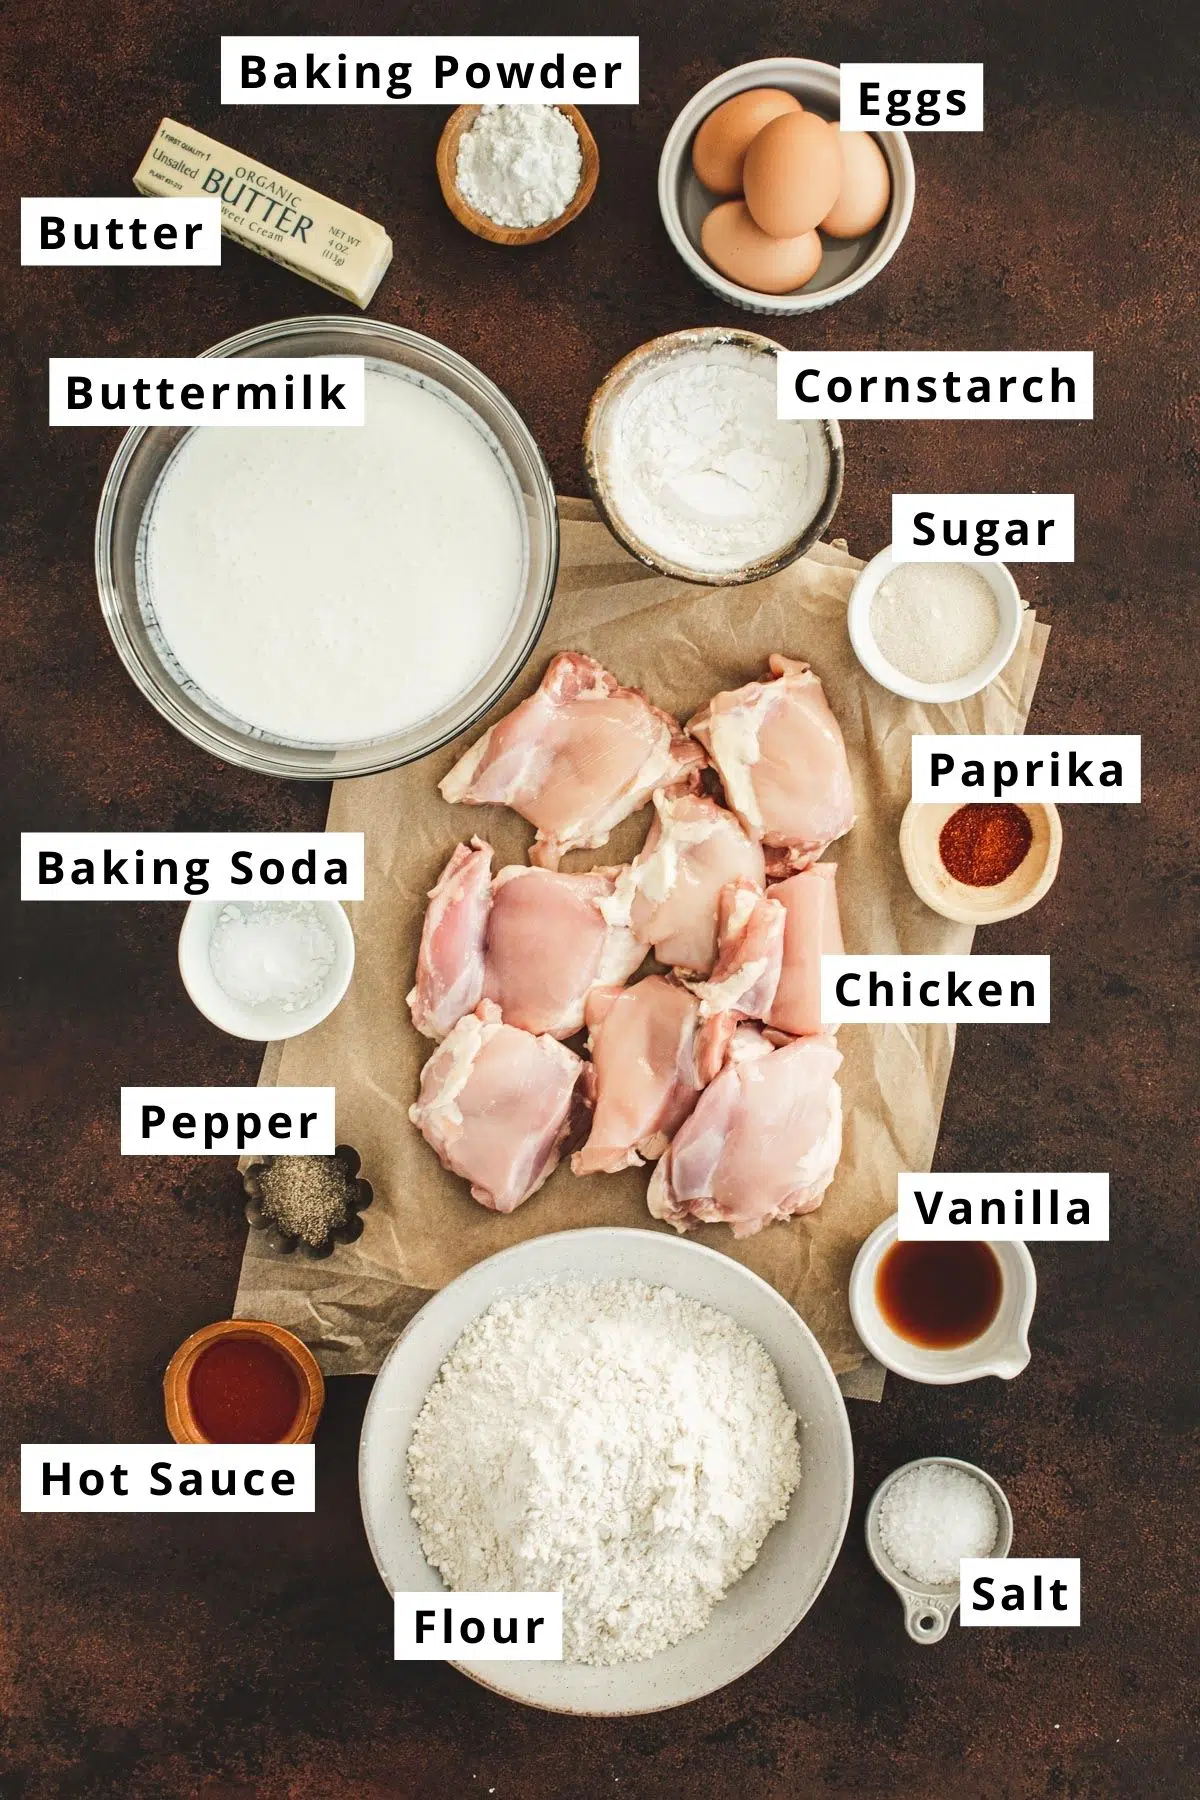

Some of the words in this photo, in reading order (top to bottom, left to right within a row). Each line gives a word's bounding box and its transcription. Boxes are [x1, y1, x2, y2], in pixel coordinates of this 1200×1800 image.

[165, 134, 181, 146] FIRST
[181, 142, 205, 159] QUALITY
[149, 169, 165, 181] PLANT
[152, 148, 200, 179] Unsalted
[234, 166, 303, 208] ORGANIC
[201, 167, 314, 244] BUTTER
[221, 206, 246, 226] weet
[248, 221, 284, 243] Cream
[329, 226, 346, 239] NET
[347, 235, 362, 247] WT
[328, 239, 334, 247] 4
[322, 249, 346, 267] (113g)
